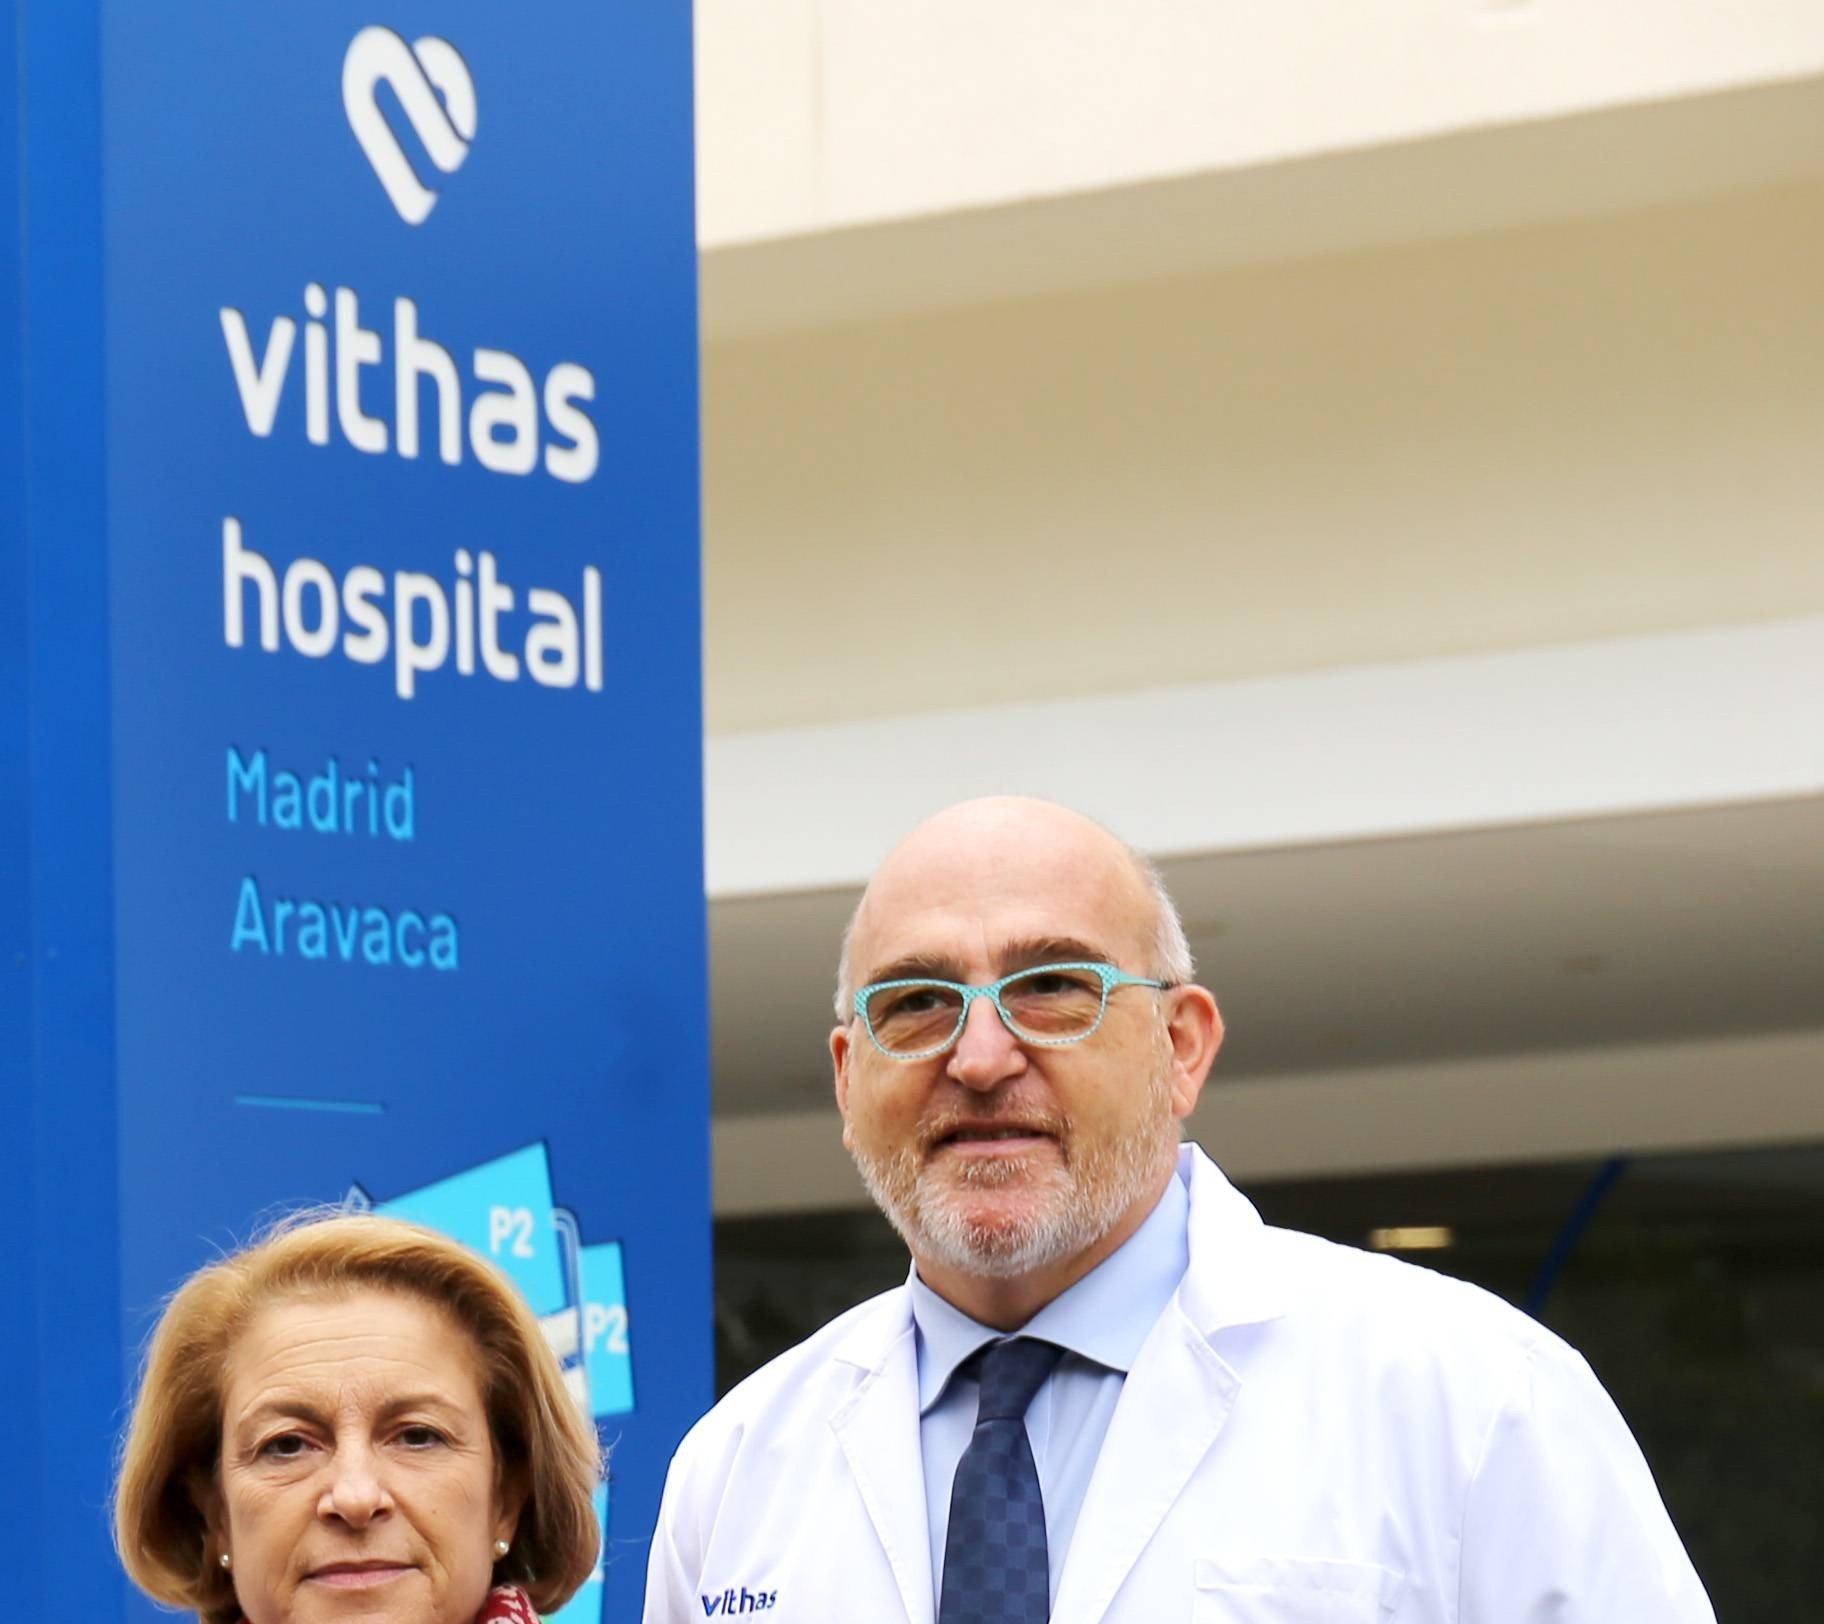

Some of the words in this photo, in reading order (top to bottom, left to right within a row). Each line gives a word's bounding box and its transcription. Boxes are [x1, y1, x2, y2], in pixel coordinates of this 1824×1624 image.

[219, 281, 601, 485] vithas
[222, 516, 603, 700] hospital
[225, 744, 415, 842] Madrid
[230, 875, 459, 971] Aravaca
[489, 1205, 535, 1260] P2
[584, 1302, 629, 1355] P2
[701, 1586, 778, 1617] vithas
